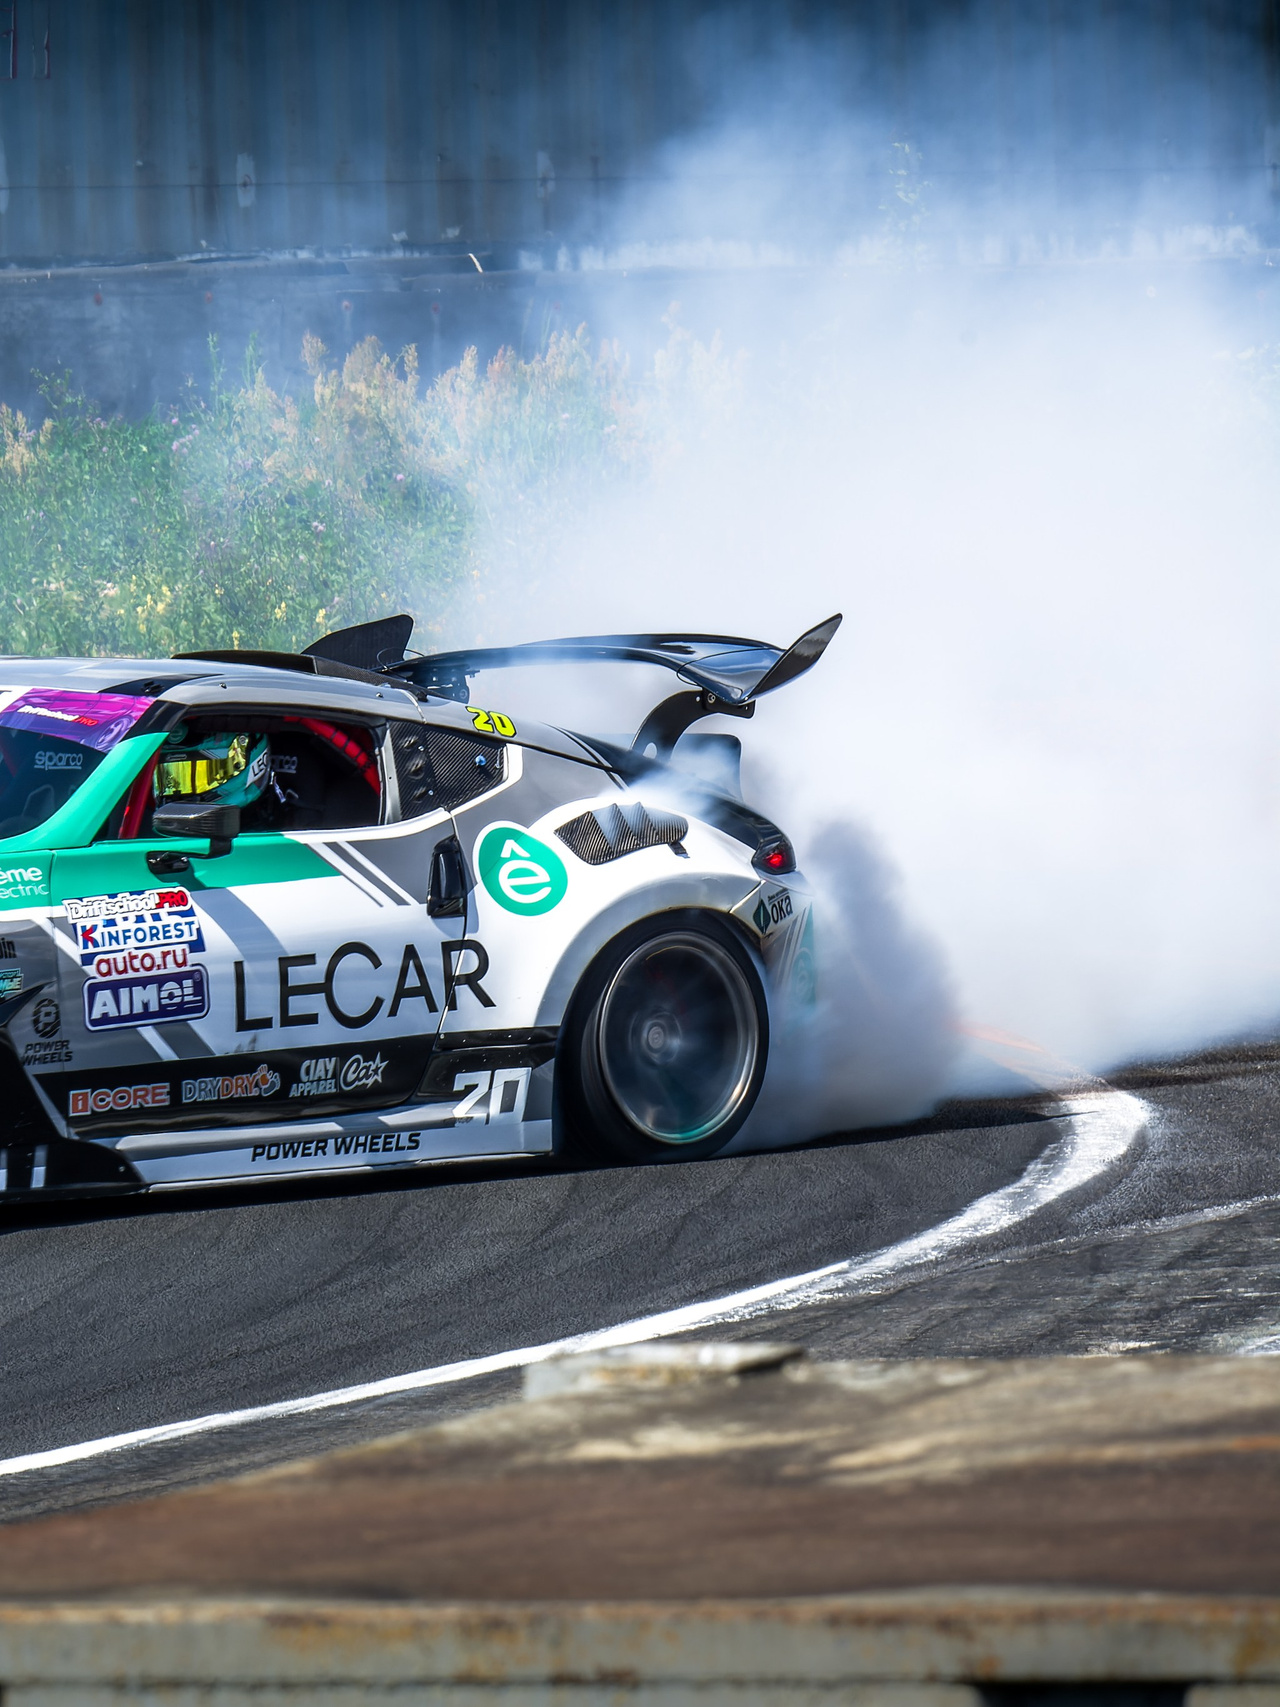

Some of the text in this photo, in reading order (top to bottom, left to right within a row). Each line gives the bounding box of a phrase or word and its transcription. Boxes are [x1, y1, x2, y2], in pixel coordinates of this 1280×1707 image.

[465, 706, 517, 738] 20
[35, 751, 83, 771] sparco
[80, 921, 196, 950] KINFOREST
[95, 948, 188, 977] auto.ru
[90, 979, 203, 1020] AIMOL
[233, 939, 497, 1032] LECAR
[22, 1051, 73, 1066] WHEELS
[25, 1040, 70, 1054] POWER
[288, 1079, 337, 1098] APPAREL
[452, 1067, 532, 1125] 20
[251, 1133, 421, 1162] POWER WHEELS
